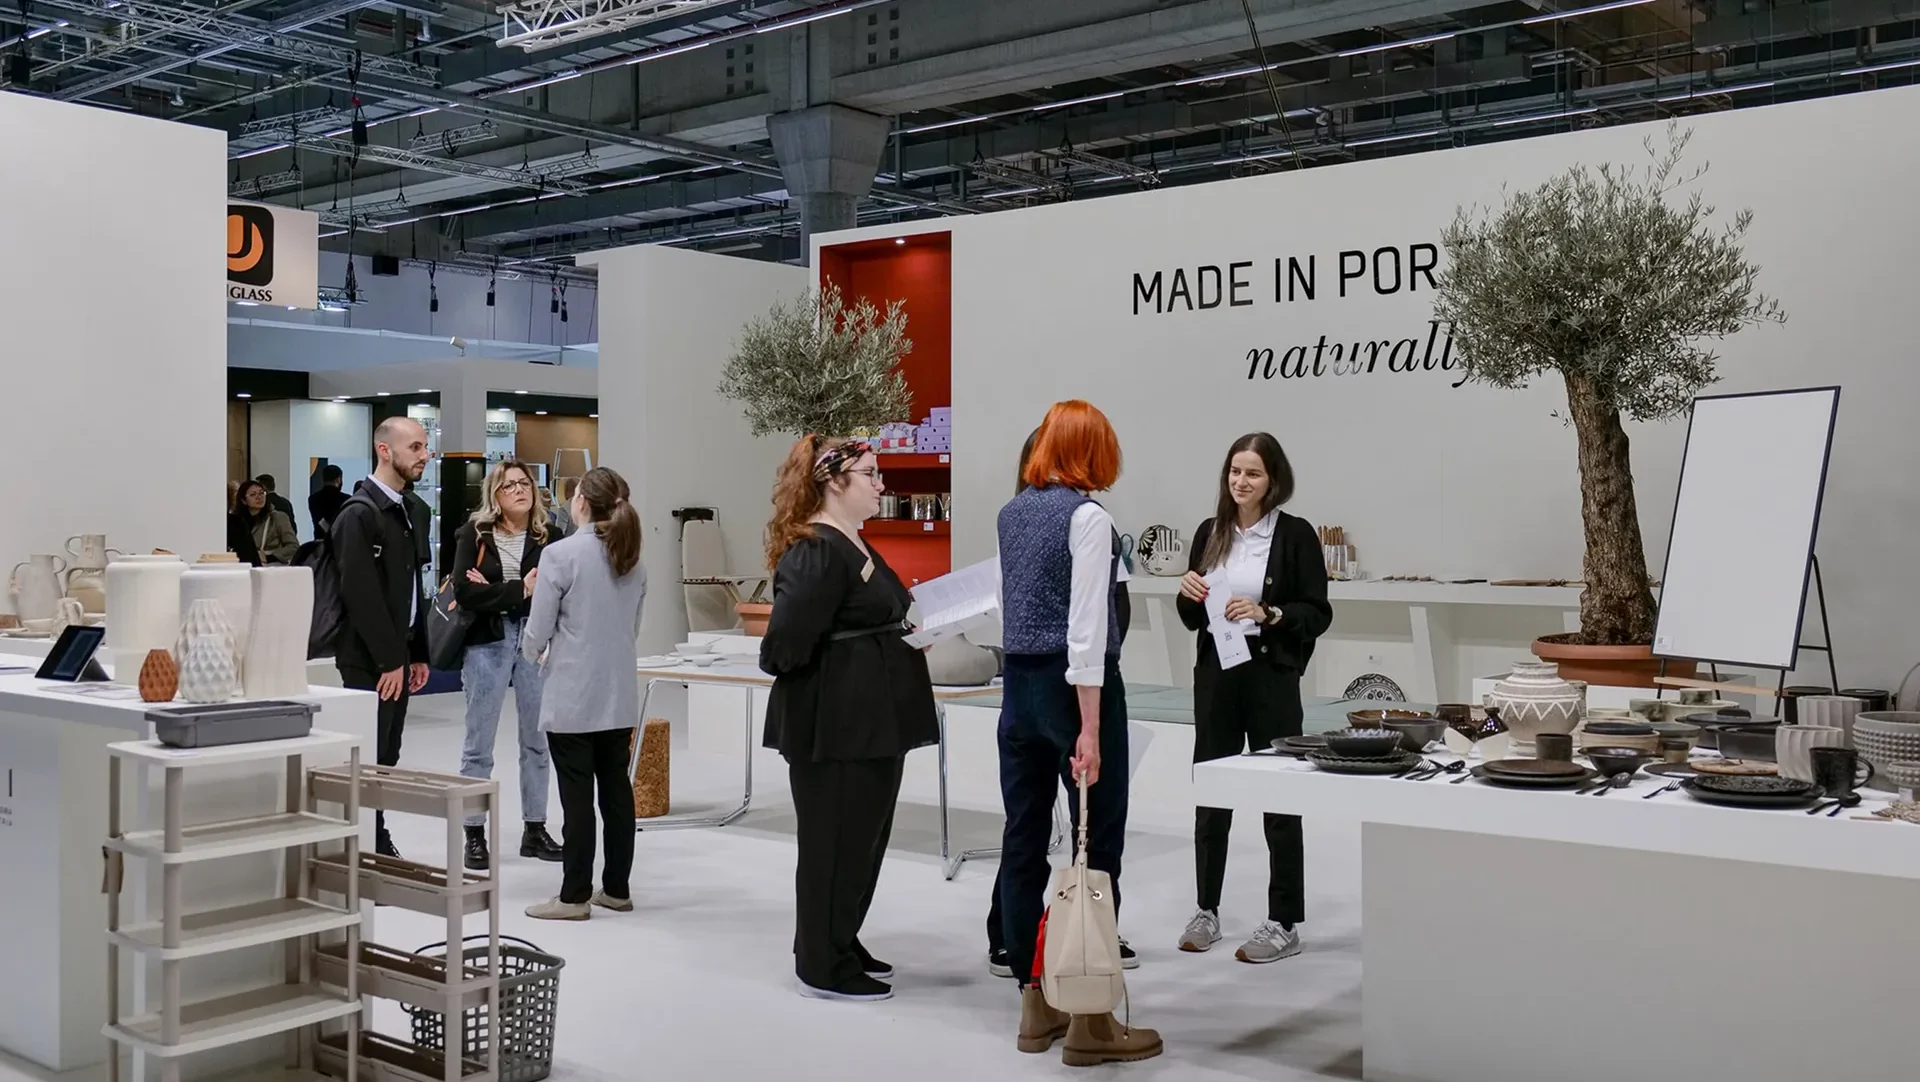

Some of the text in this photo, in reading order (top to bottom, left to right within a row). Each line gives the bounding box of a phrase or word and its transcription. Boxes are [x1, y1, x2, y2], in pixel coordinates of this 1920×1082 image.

[1132, 242, 1440, 315] MADE IN POR
